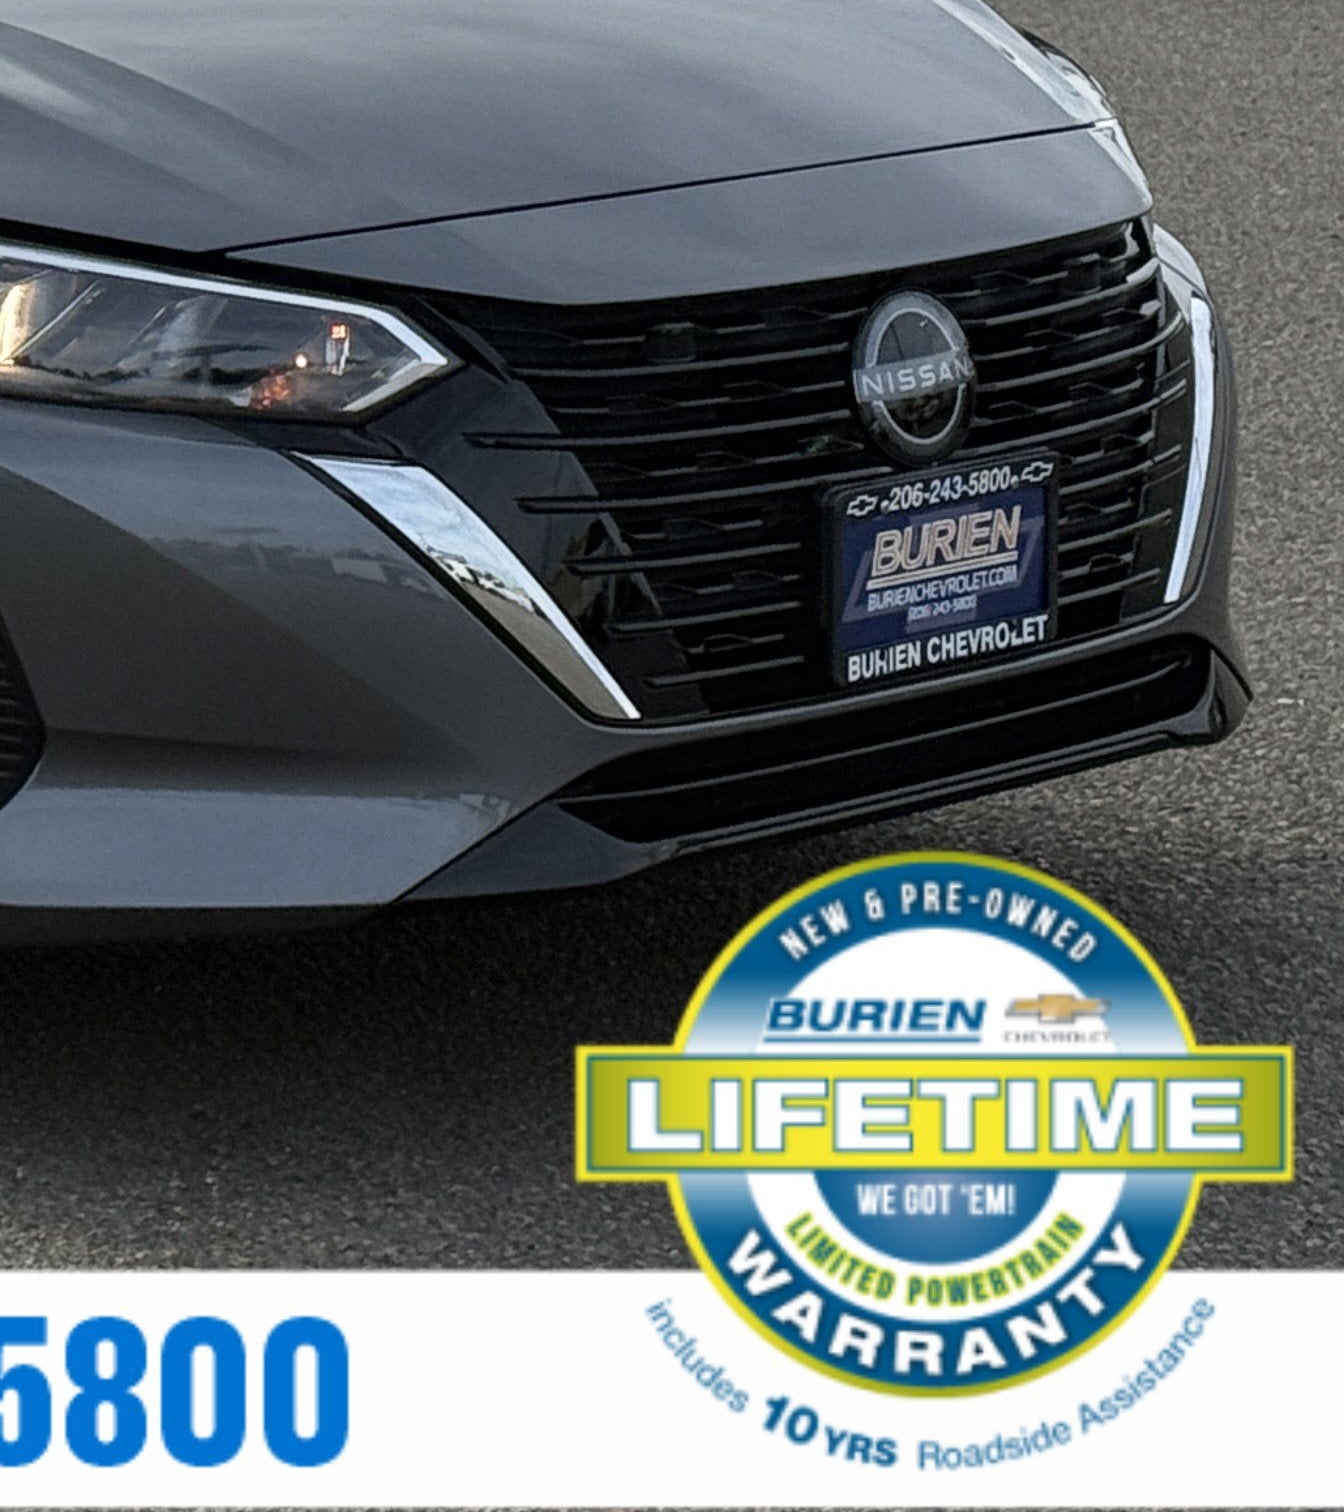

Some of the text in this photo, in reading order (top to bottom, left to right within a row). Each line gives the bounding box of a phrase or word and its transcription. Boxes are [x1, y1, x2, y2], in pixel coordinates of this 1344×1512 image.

[860, 354, 972, 396] NISSAN
[888, 465, 1011, 511] 206-243-5800
[871, 505, 1022, 577] BURIEN
